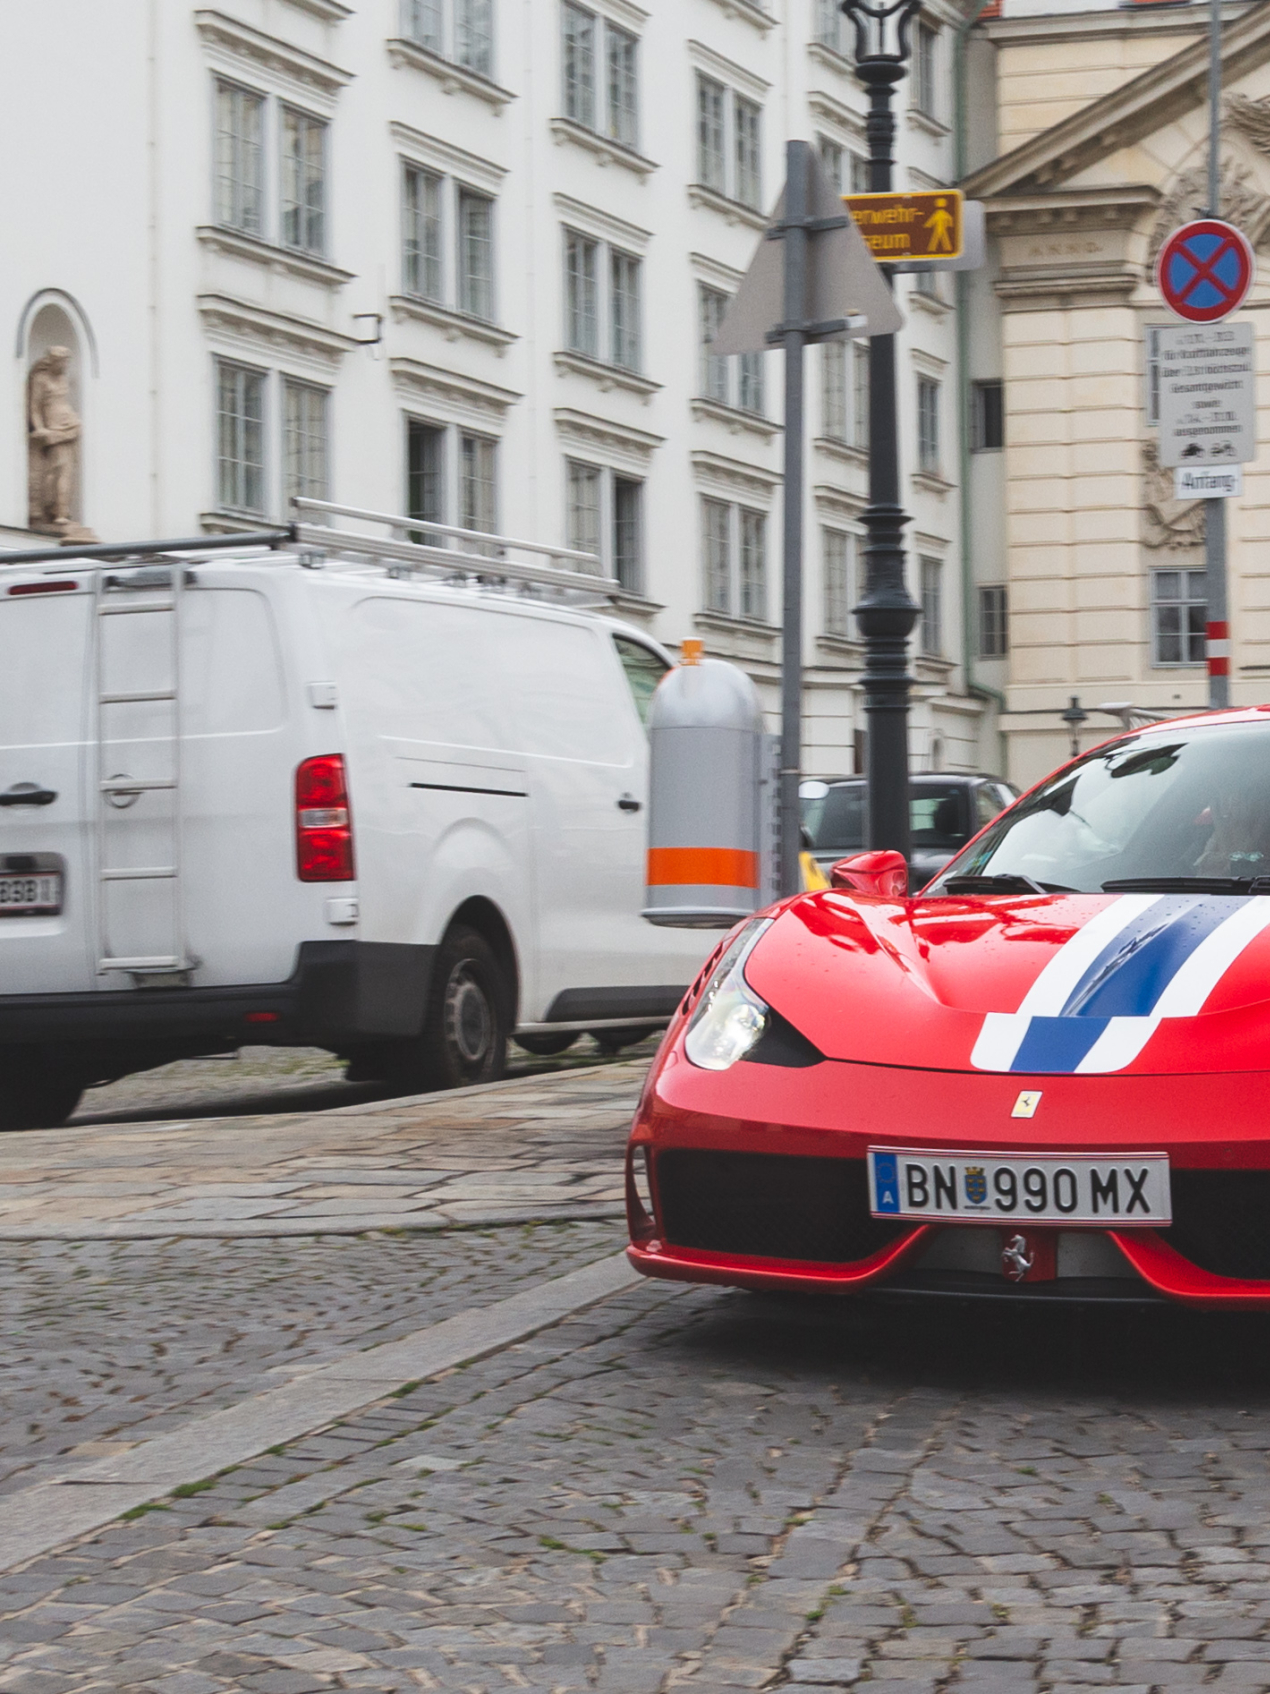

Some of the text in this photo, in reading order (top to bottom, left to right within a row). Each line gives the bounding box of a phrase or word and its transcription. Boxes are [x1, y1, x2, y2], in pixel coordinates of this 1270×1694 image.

[1181, 471, 1234, 492] Anfang
[881, 1163, 1151, 1213] A BN 990 MX
